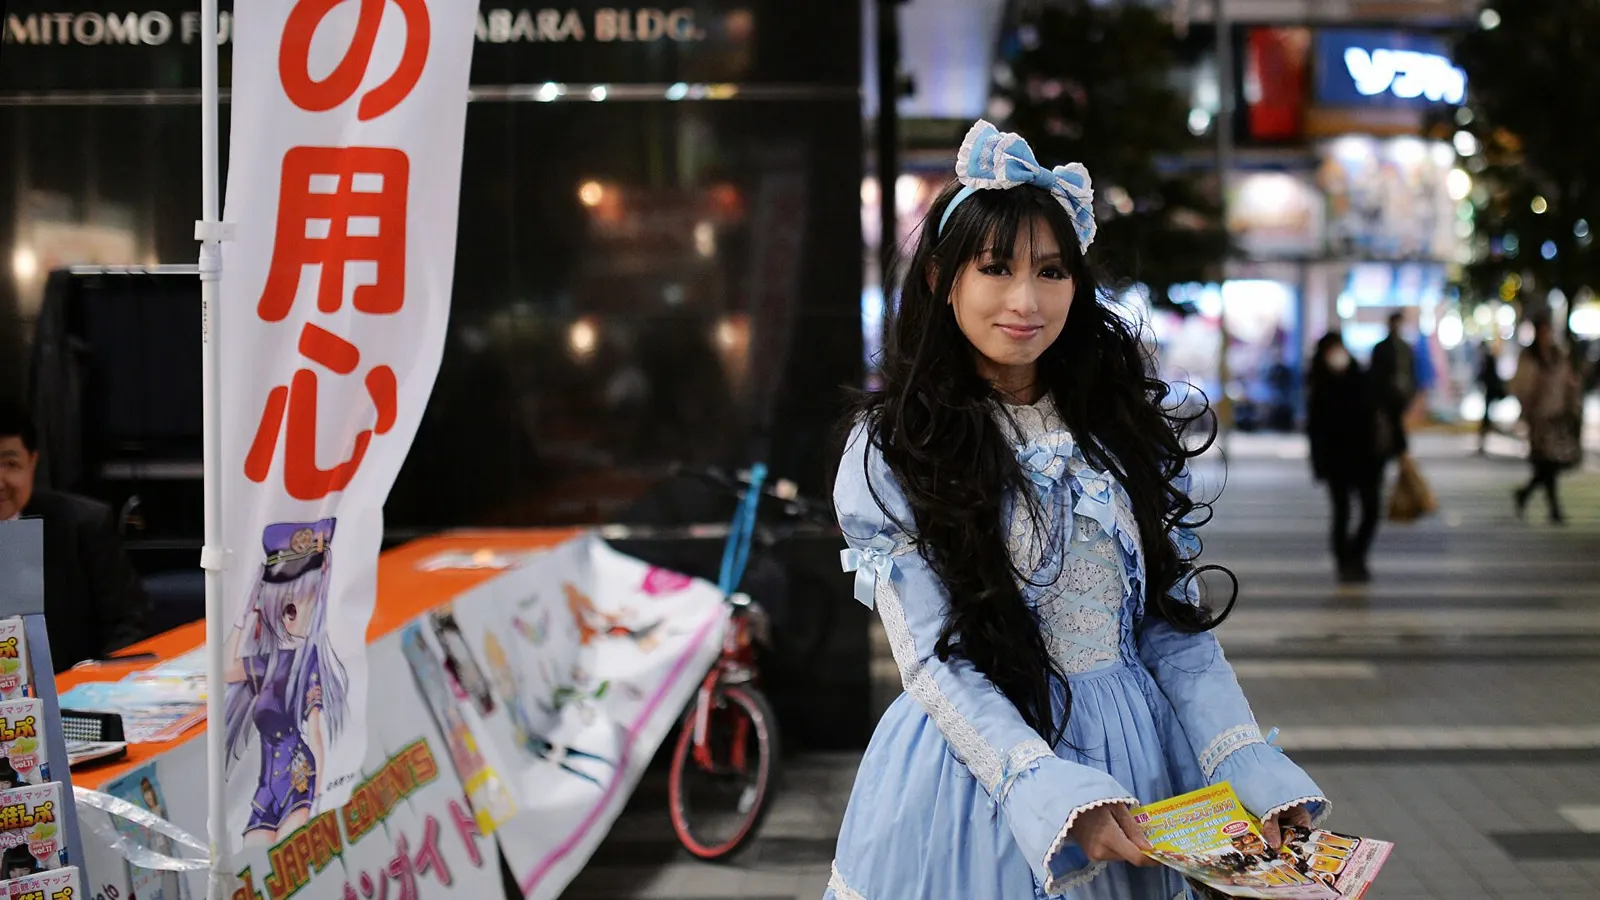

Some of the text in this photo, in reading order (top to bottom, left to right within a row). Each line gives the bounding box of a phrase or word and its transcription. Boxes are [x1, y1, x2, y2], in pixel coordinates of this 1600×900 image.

[6, 11, 173, 45] MITOMO
[244, 0, 430, 501] の用心
[0, 788, 52, 805] 観光マップ
